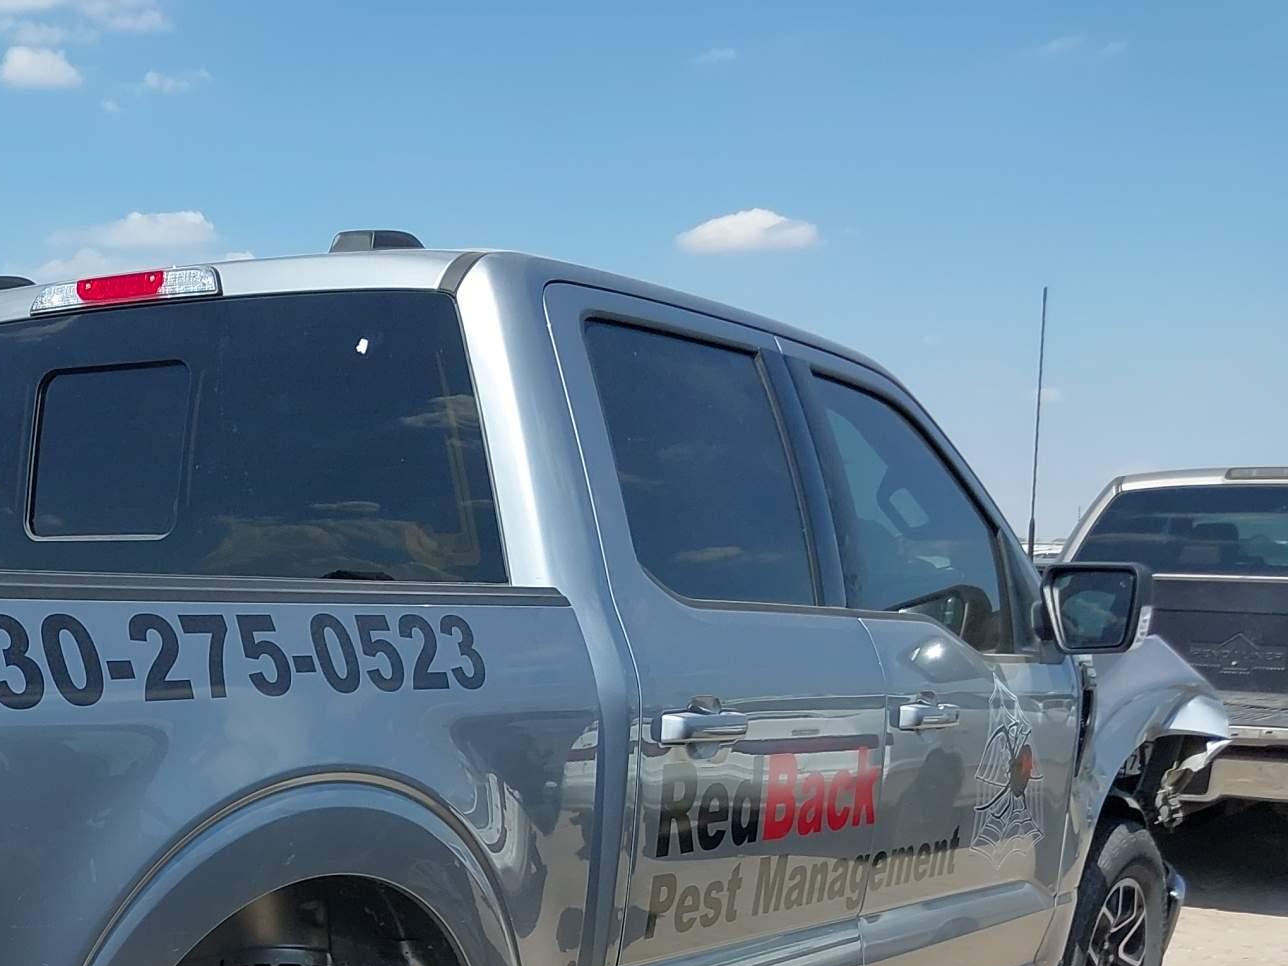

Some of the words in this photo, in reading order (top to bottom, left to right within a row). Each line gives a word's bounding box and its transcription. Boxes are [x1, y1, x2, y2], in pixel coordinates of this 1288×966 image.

[655, 747, 881, 857] RedBack
[646, 864, 742, 938] Pest
[752, 828, 960, 913] Management
